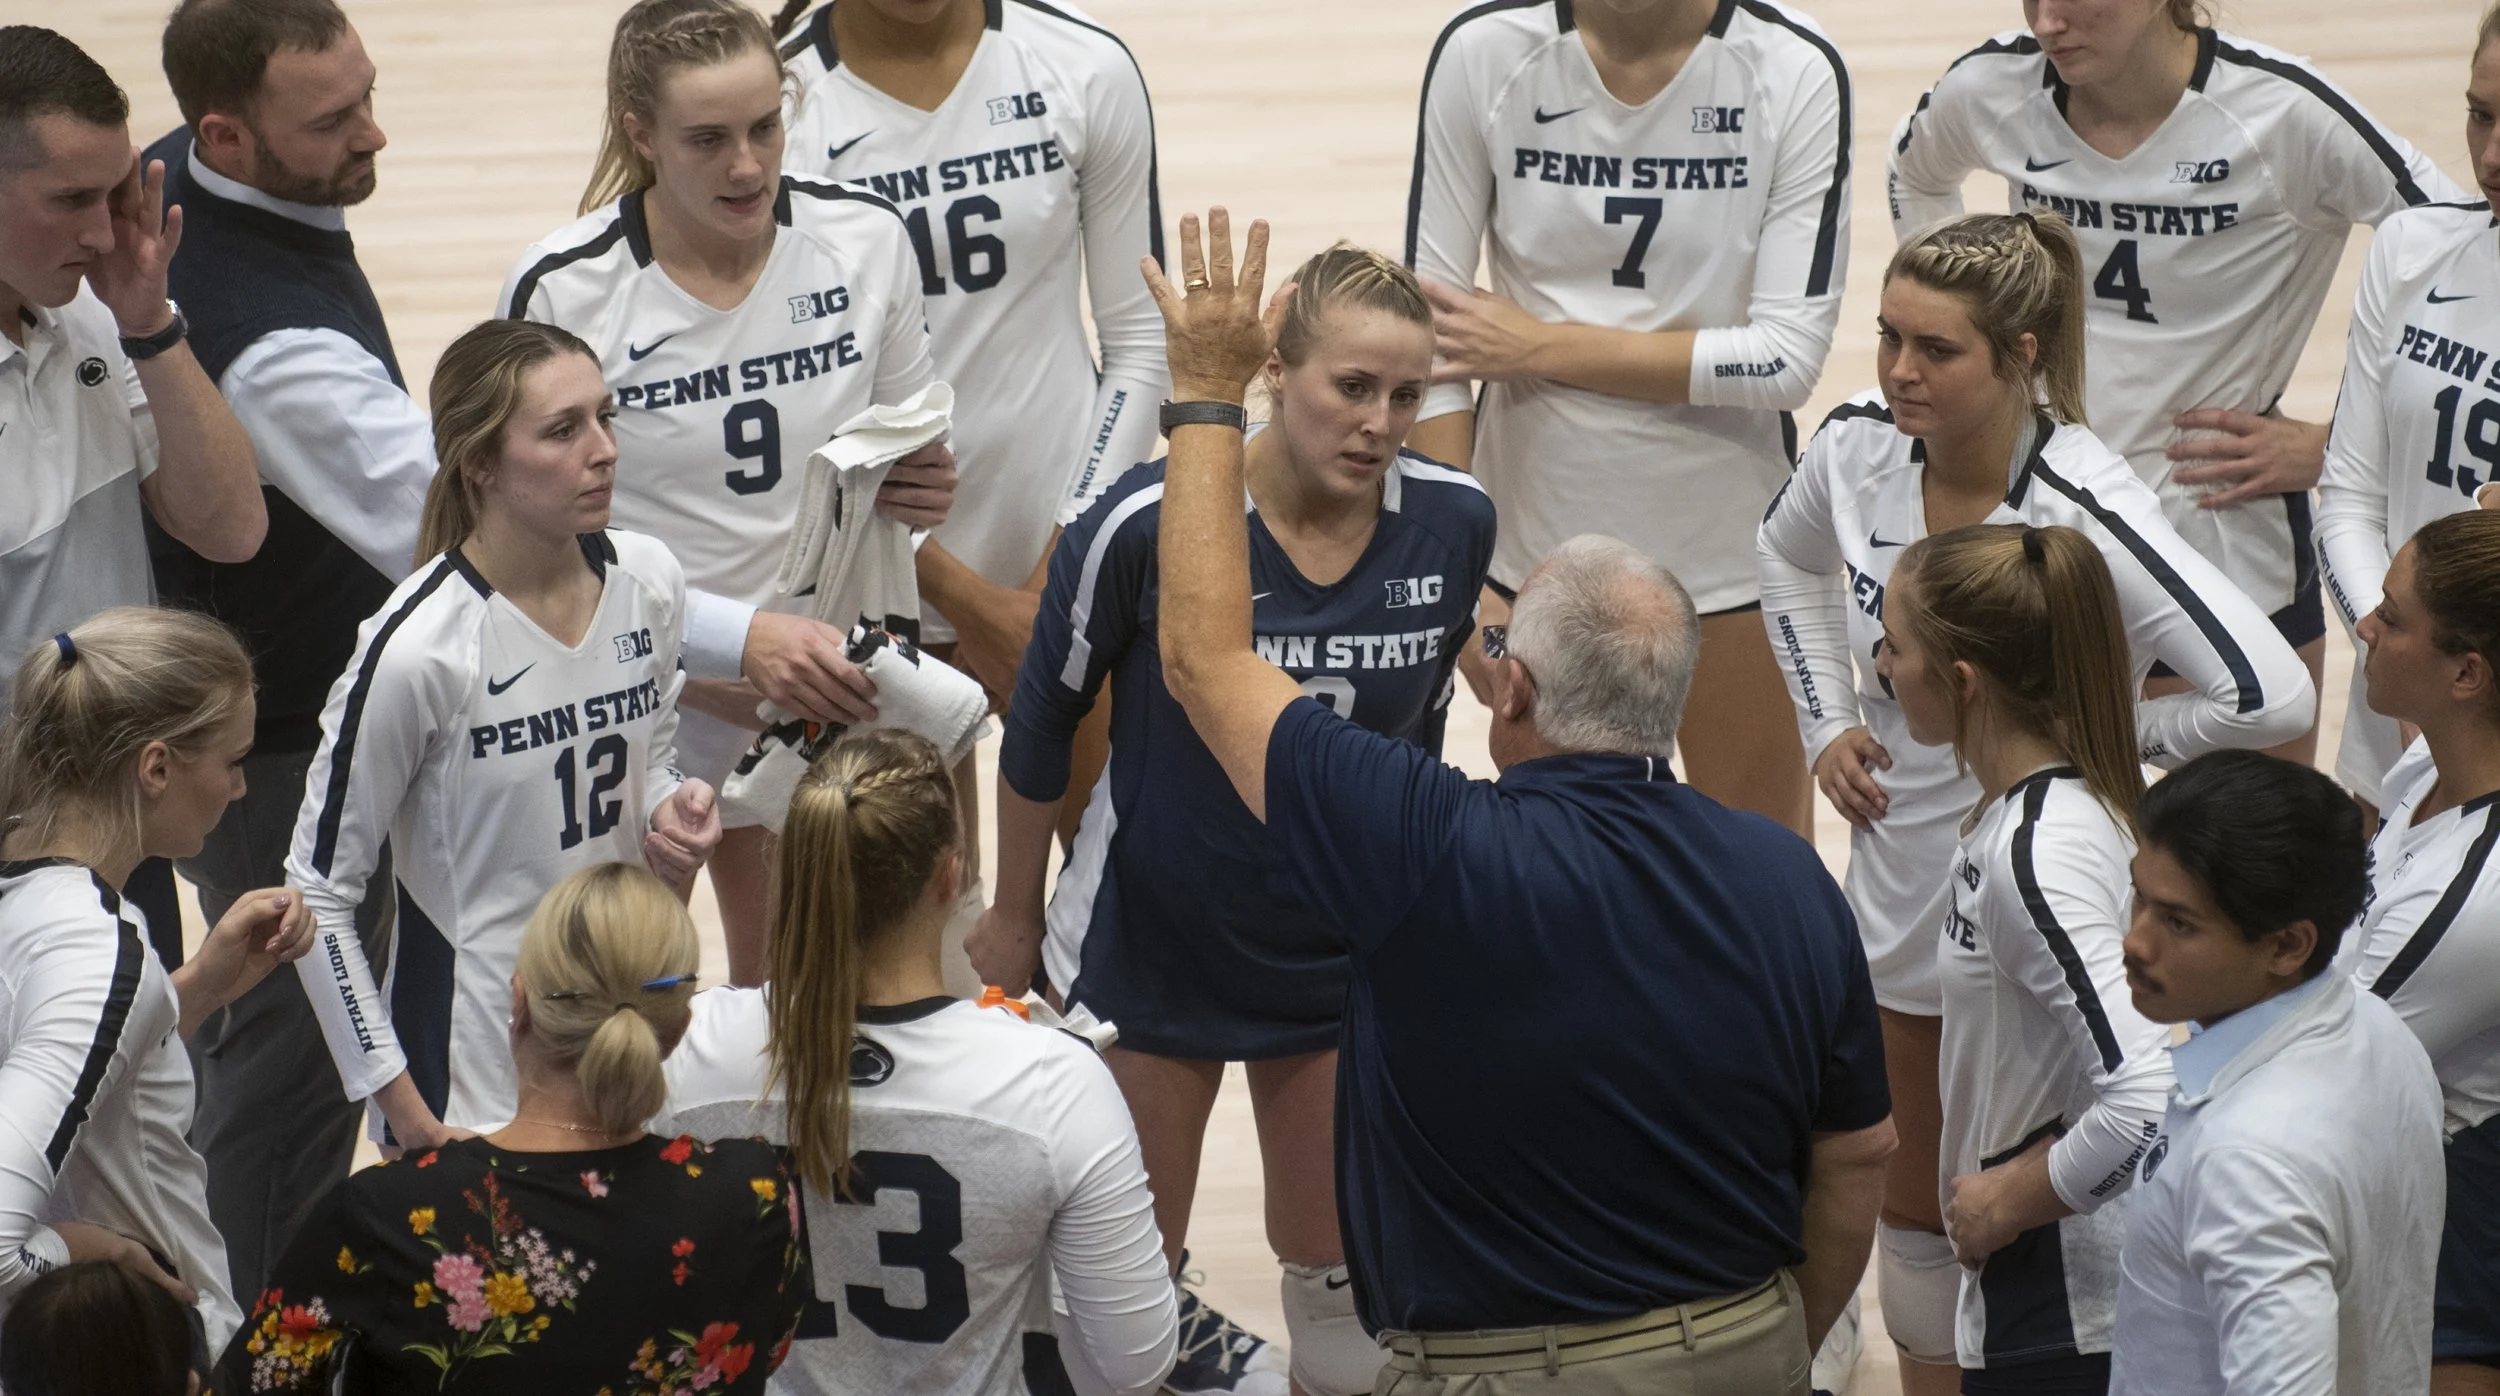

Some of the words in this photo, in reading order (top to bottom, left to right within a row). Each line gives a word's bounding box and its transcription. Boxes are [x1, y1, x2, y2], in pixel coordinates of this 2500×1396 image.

[847, 165, 930, 203] NN
[938, 140, 1065, 192] STATE
[1513, 148, 1622, 188] PENN
[1632, 156, 1748, 190] STATE
[1603, 196, 1663, 289] 7
[2022, 183, 2103, 229] PNN
[2109, 202, 2239, 236] STATE
[904, 194, 1007, 296] 16
[2093, 239, 2159, 325] 4
[617, 364, 732, 410] PENN
[740, 331, 862, 393] STATE
[2396, 324, 2489, 383] PENN
[723, 398, 783, 496] 9
[1093, 389, 1128, 455] NITTANY
[2426, 384, 2500, 498] 19
[1074, 456, 1100, 499] LIONS
[2327, 572, 2358, 626] NITTANY
[1255, 635, 1316, 668] NN
[1326, 627, 1446, 669] STATE
[470, 703, 579, 759] PENN
[584, 677, 660, 733] STATE
[1794, 657, 1824, 720] NITTANY
[554, 733, 628, 852] 12
[324, 933, 349, 982] LIONS
[340, 984, 376, 1054] NITTANY
